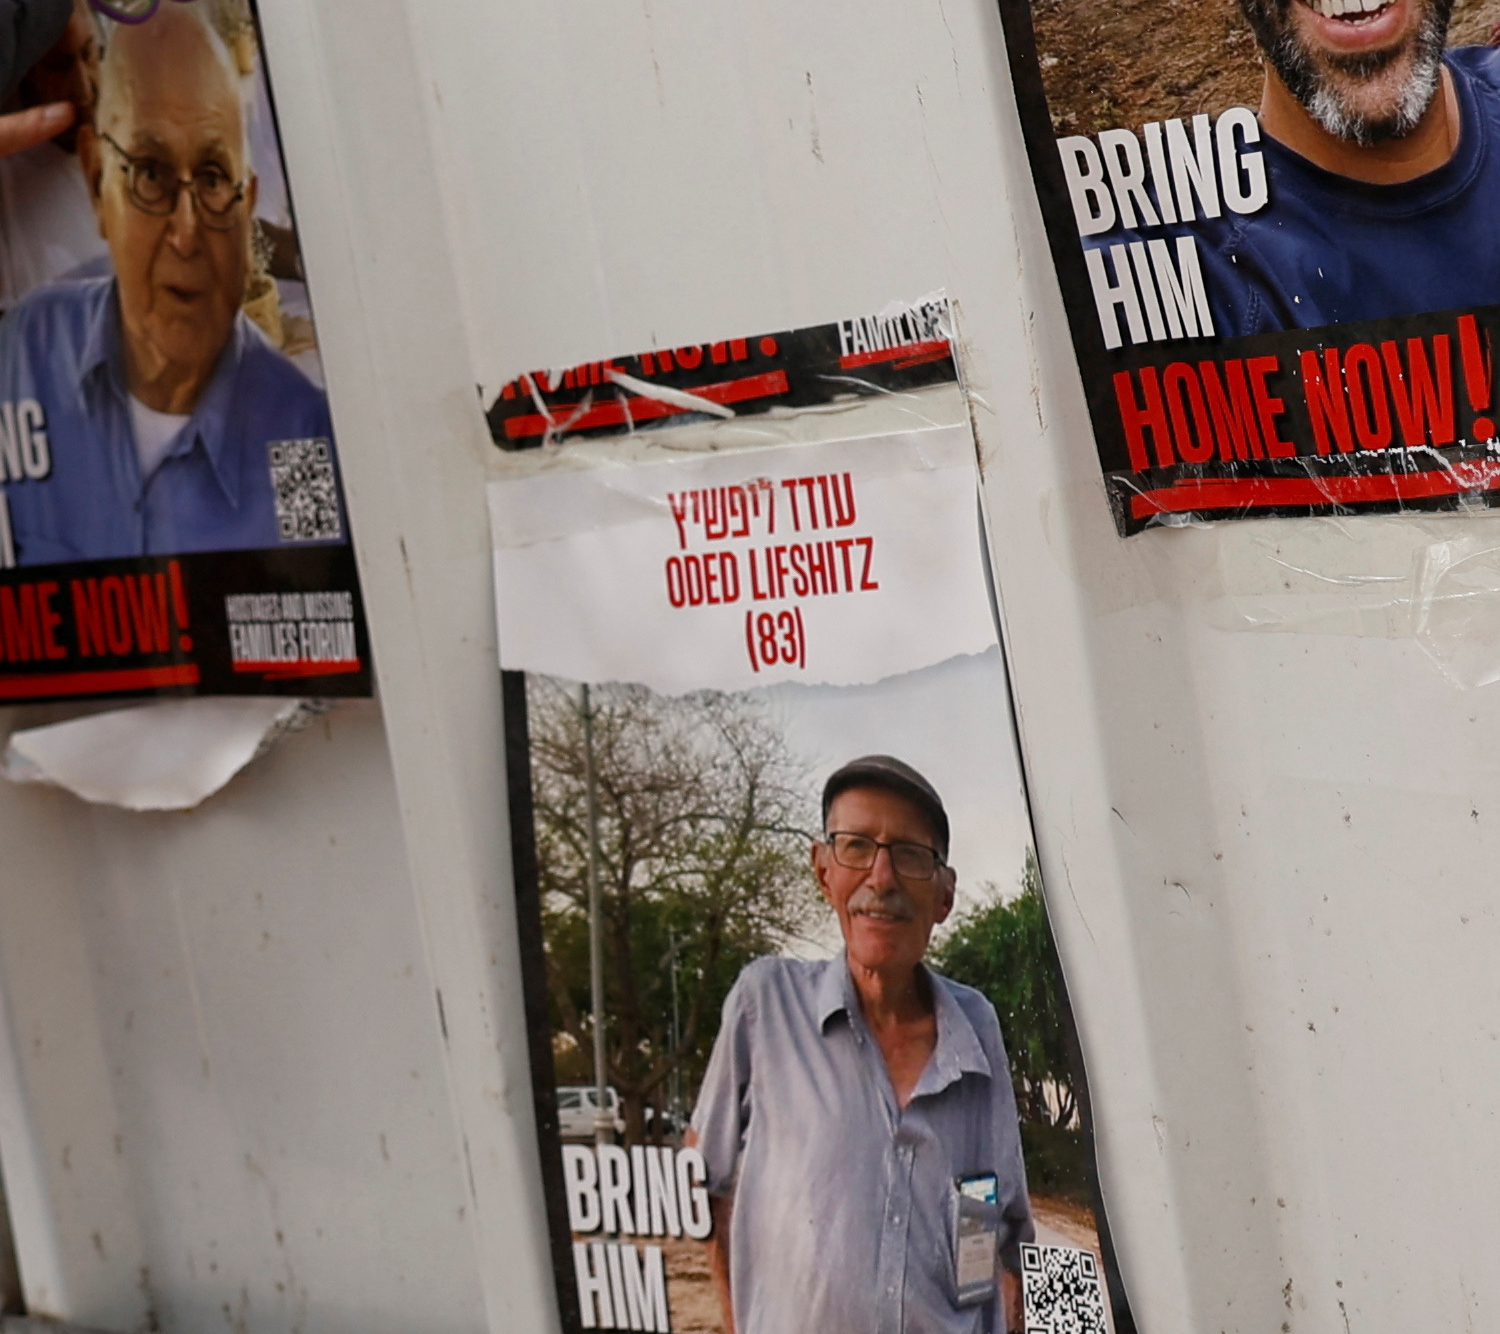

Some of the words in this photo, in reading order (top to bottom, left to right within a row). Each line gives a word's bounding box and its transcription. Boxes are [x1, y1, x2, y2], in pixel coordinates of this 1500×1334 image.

[1056, 106, 1269, 238] BRING
[1084, 235, 1216, 351] HIM
[1112, 354, 1297, 474] HOME
[1300, 313, 1498, 457] NOW!
[667, 477, 775, 550] ליפשיץ
[781, 472, 857, 533] עודד
[70, 558, 195, 658] NOW!
[665, 550, 741, 609] ODED
[748, 536, 880, 602] LIFSHITZ
[745, 605, 806, 674] (83)
[561, 1142, 713, 1240] BRING
[572, 1240, 670, 1334] HIM
